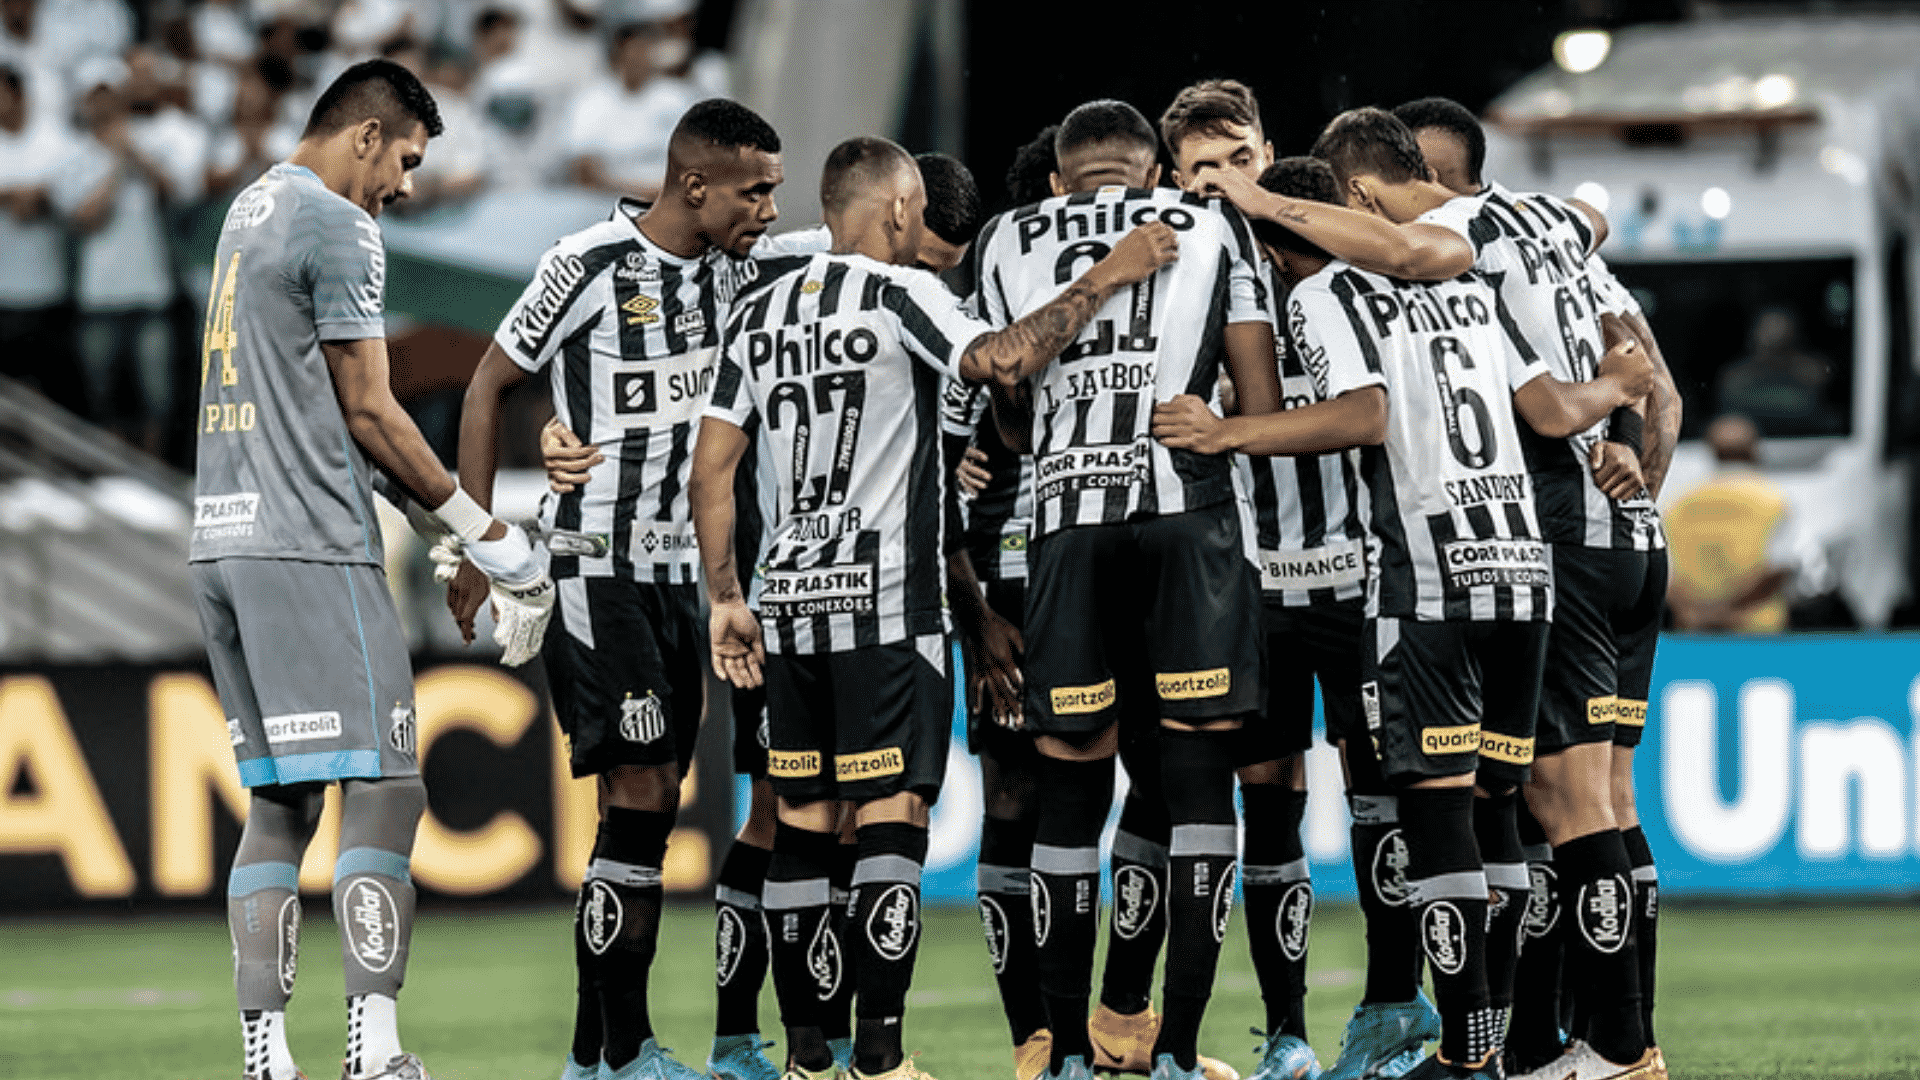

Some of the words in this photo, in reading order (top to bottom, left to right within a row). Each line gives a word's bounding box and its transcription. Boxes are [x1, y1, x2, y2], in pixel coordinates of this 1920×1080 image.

[1019, 202, 1195, 255] Philco
[202, 251, 238, 386] 4
[750, 322, 878, 382] Philco
[767, 369, 866, 514] 27
[1429, 336, 1498, 469] 6
[1269, 553, 1358, 578] BINANCE
[1658, 674, 1920, 863] Un
[353, 884, 388, 961] Kodilar
